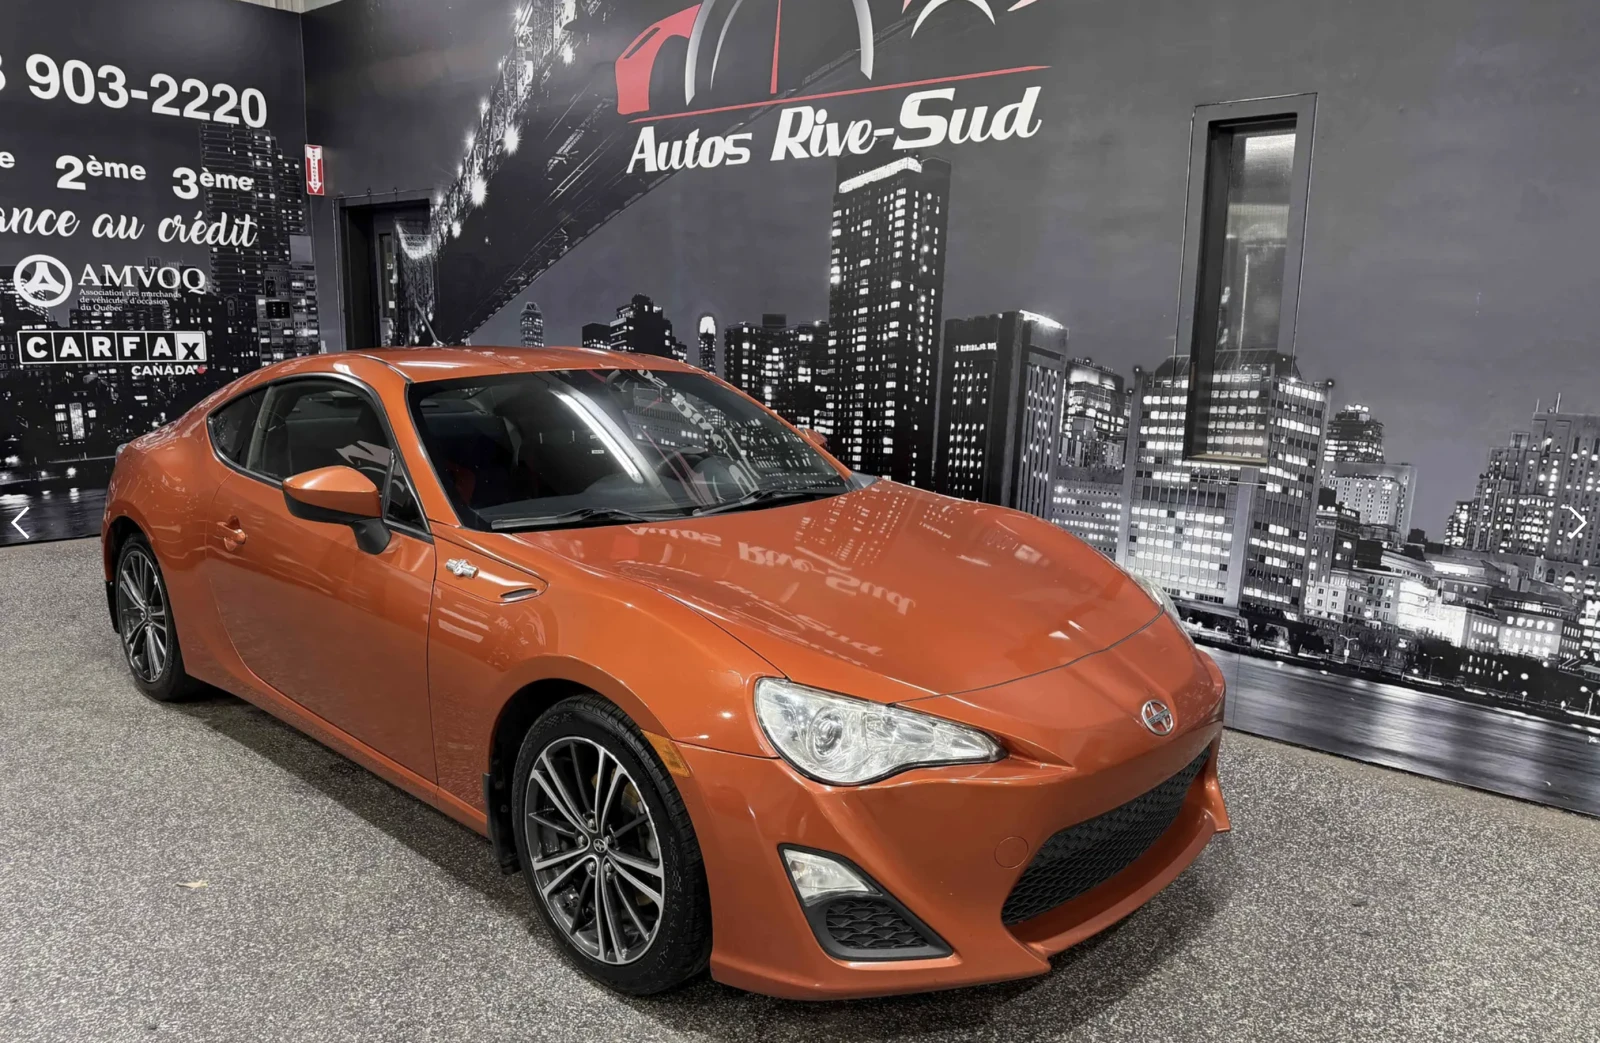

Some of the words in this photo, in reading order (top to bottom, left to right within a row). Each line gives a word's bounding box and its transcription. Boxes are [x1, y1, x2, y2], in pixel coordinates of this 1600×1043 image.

[25, 53, 268, 128] 903-2220
[626, 126, 753, 174] Autos
[770, 86, 1043, 162] Rive-Sud
[55, 154, 147, 190] 2ème
[172, 167, 253, 200] 3ème
[92, 213, 145, 240] au
[157, 210, 258, 247] crédit
[78, 263, 206, 294] AMVOQ
[79, 288, 124, 296] Association
[141, 290, 181, 298] marchands
[92, 296, 128, 304] véhicules
[93, 304, 123, 312] Québec
[26, 336, 200, 361] CARFAX
[131, 364, 196, 376] CANADA
